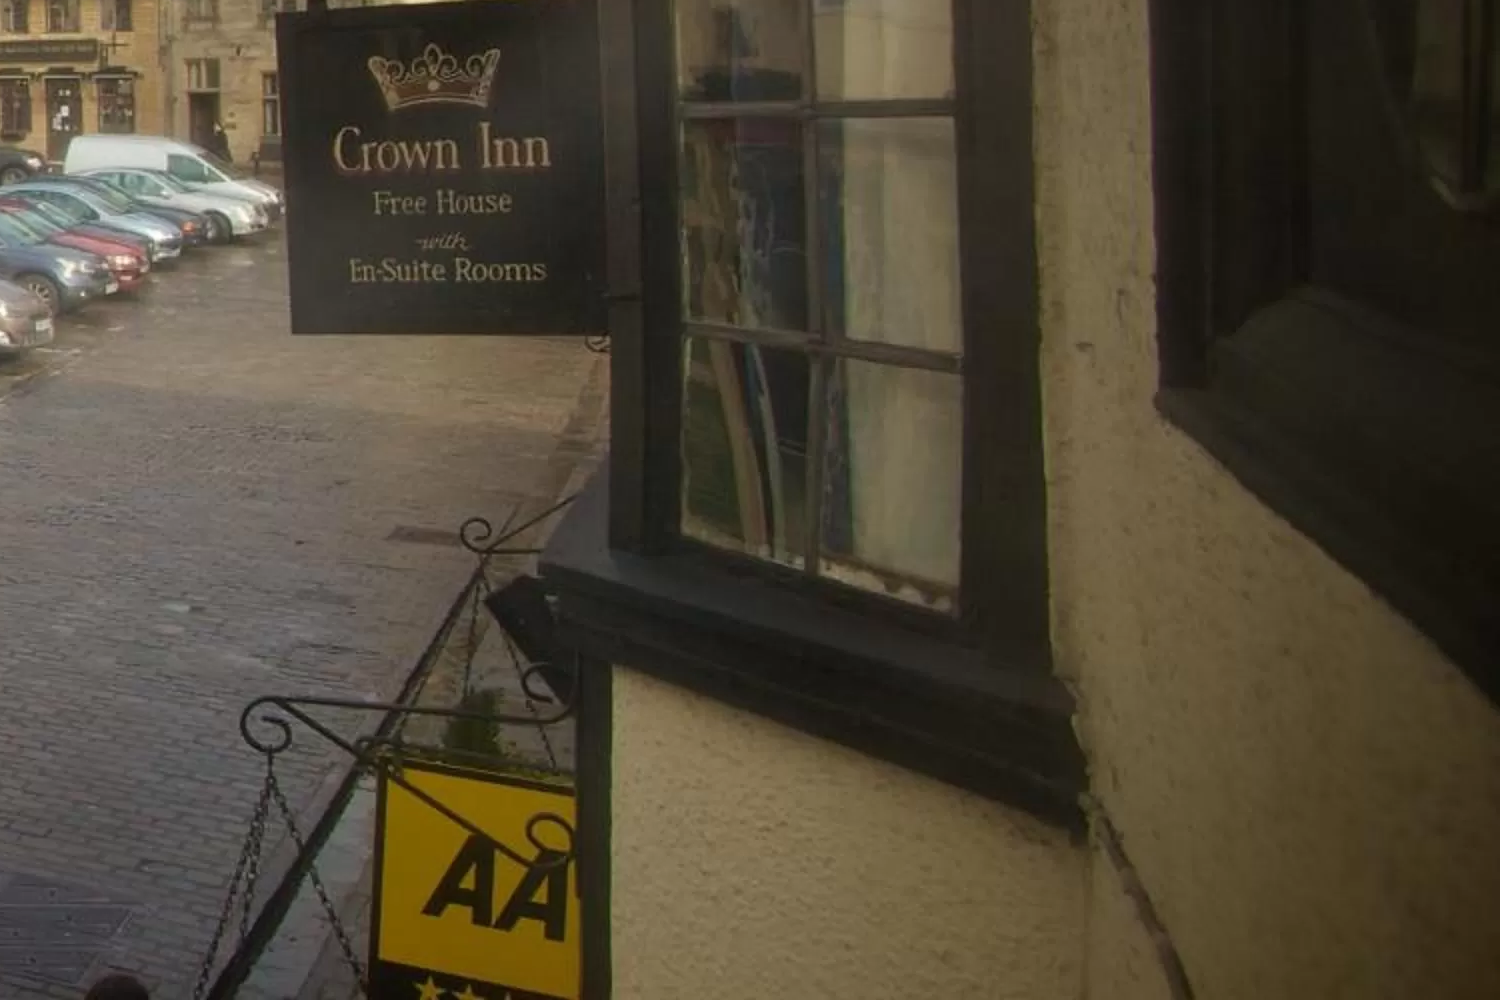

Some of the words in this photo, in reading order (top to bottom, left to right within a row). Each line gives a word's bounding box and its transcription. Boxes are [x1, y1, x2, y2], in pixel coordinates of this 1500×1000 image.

[333, 126, 461, 171] Crown
[479, 121, 551, 168] Inn
[372, 190, 428, 215] Free
[436, 189, 514, 215] House
[416, 231, 470, 251] with
[350, 257, 446, 282] En-Suite
[455, 257, 549, 282] Rooms
[420, 833, 569, 943] AA
